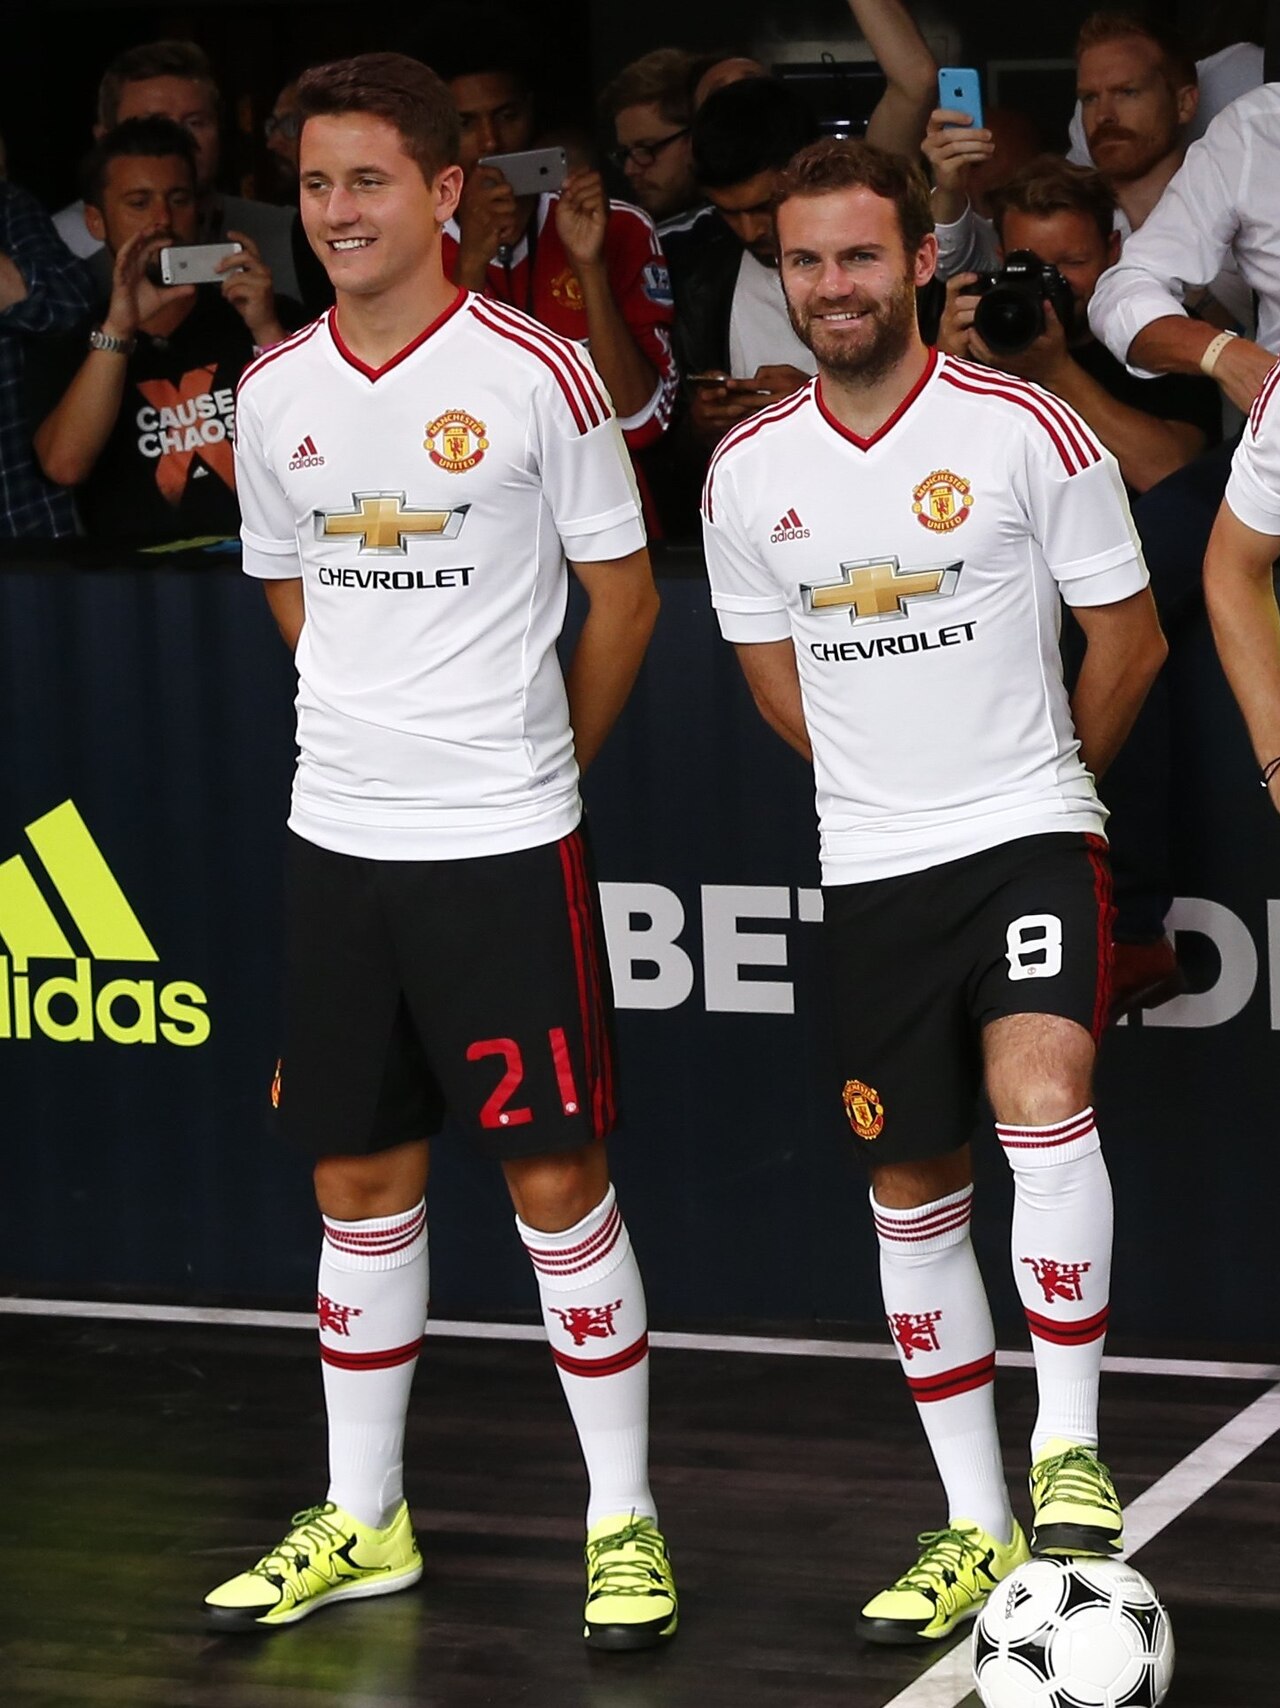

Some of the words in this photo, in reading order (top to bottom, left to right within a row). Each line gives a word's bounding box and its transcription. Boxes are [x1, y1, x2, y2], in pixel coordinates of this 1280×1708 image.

[136, 388, 235, 431] CAUSE
[138, 414, 235, 458] CHAOS
[430, 413, 482, 436] MANCHESTER
[288, 455, 325, 471] adidas
[439, 457, 476, 470] UNITED
[916, 474, 967, 498] MANCHESTER
[770, 526, 811, 544] adidas
[927, 516, 962, 530] UNITED
[318, 566, 475, 590] CHEVROLET
[810, 620, 977, 662] CHEVROLET
[1005, 913, 1063, 981] 8
[466, 1027, 580, 1129] 21
